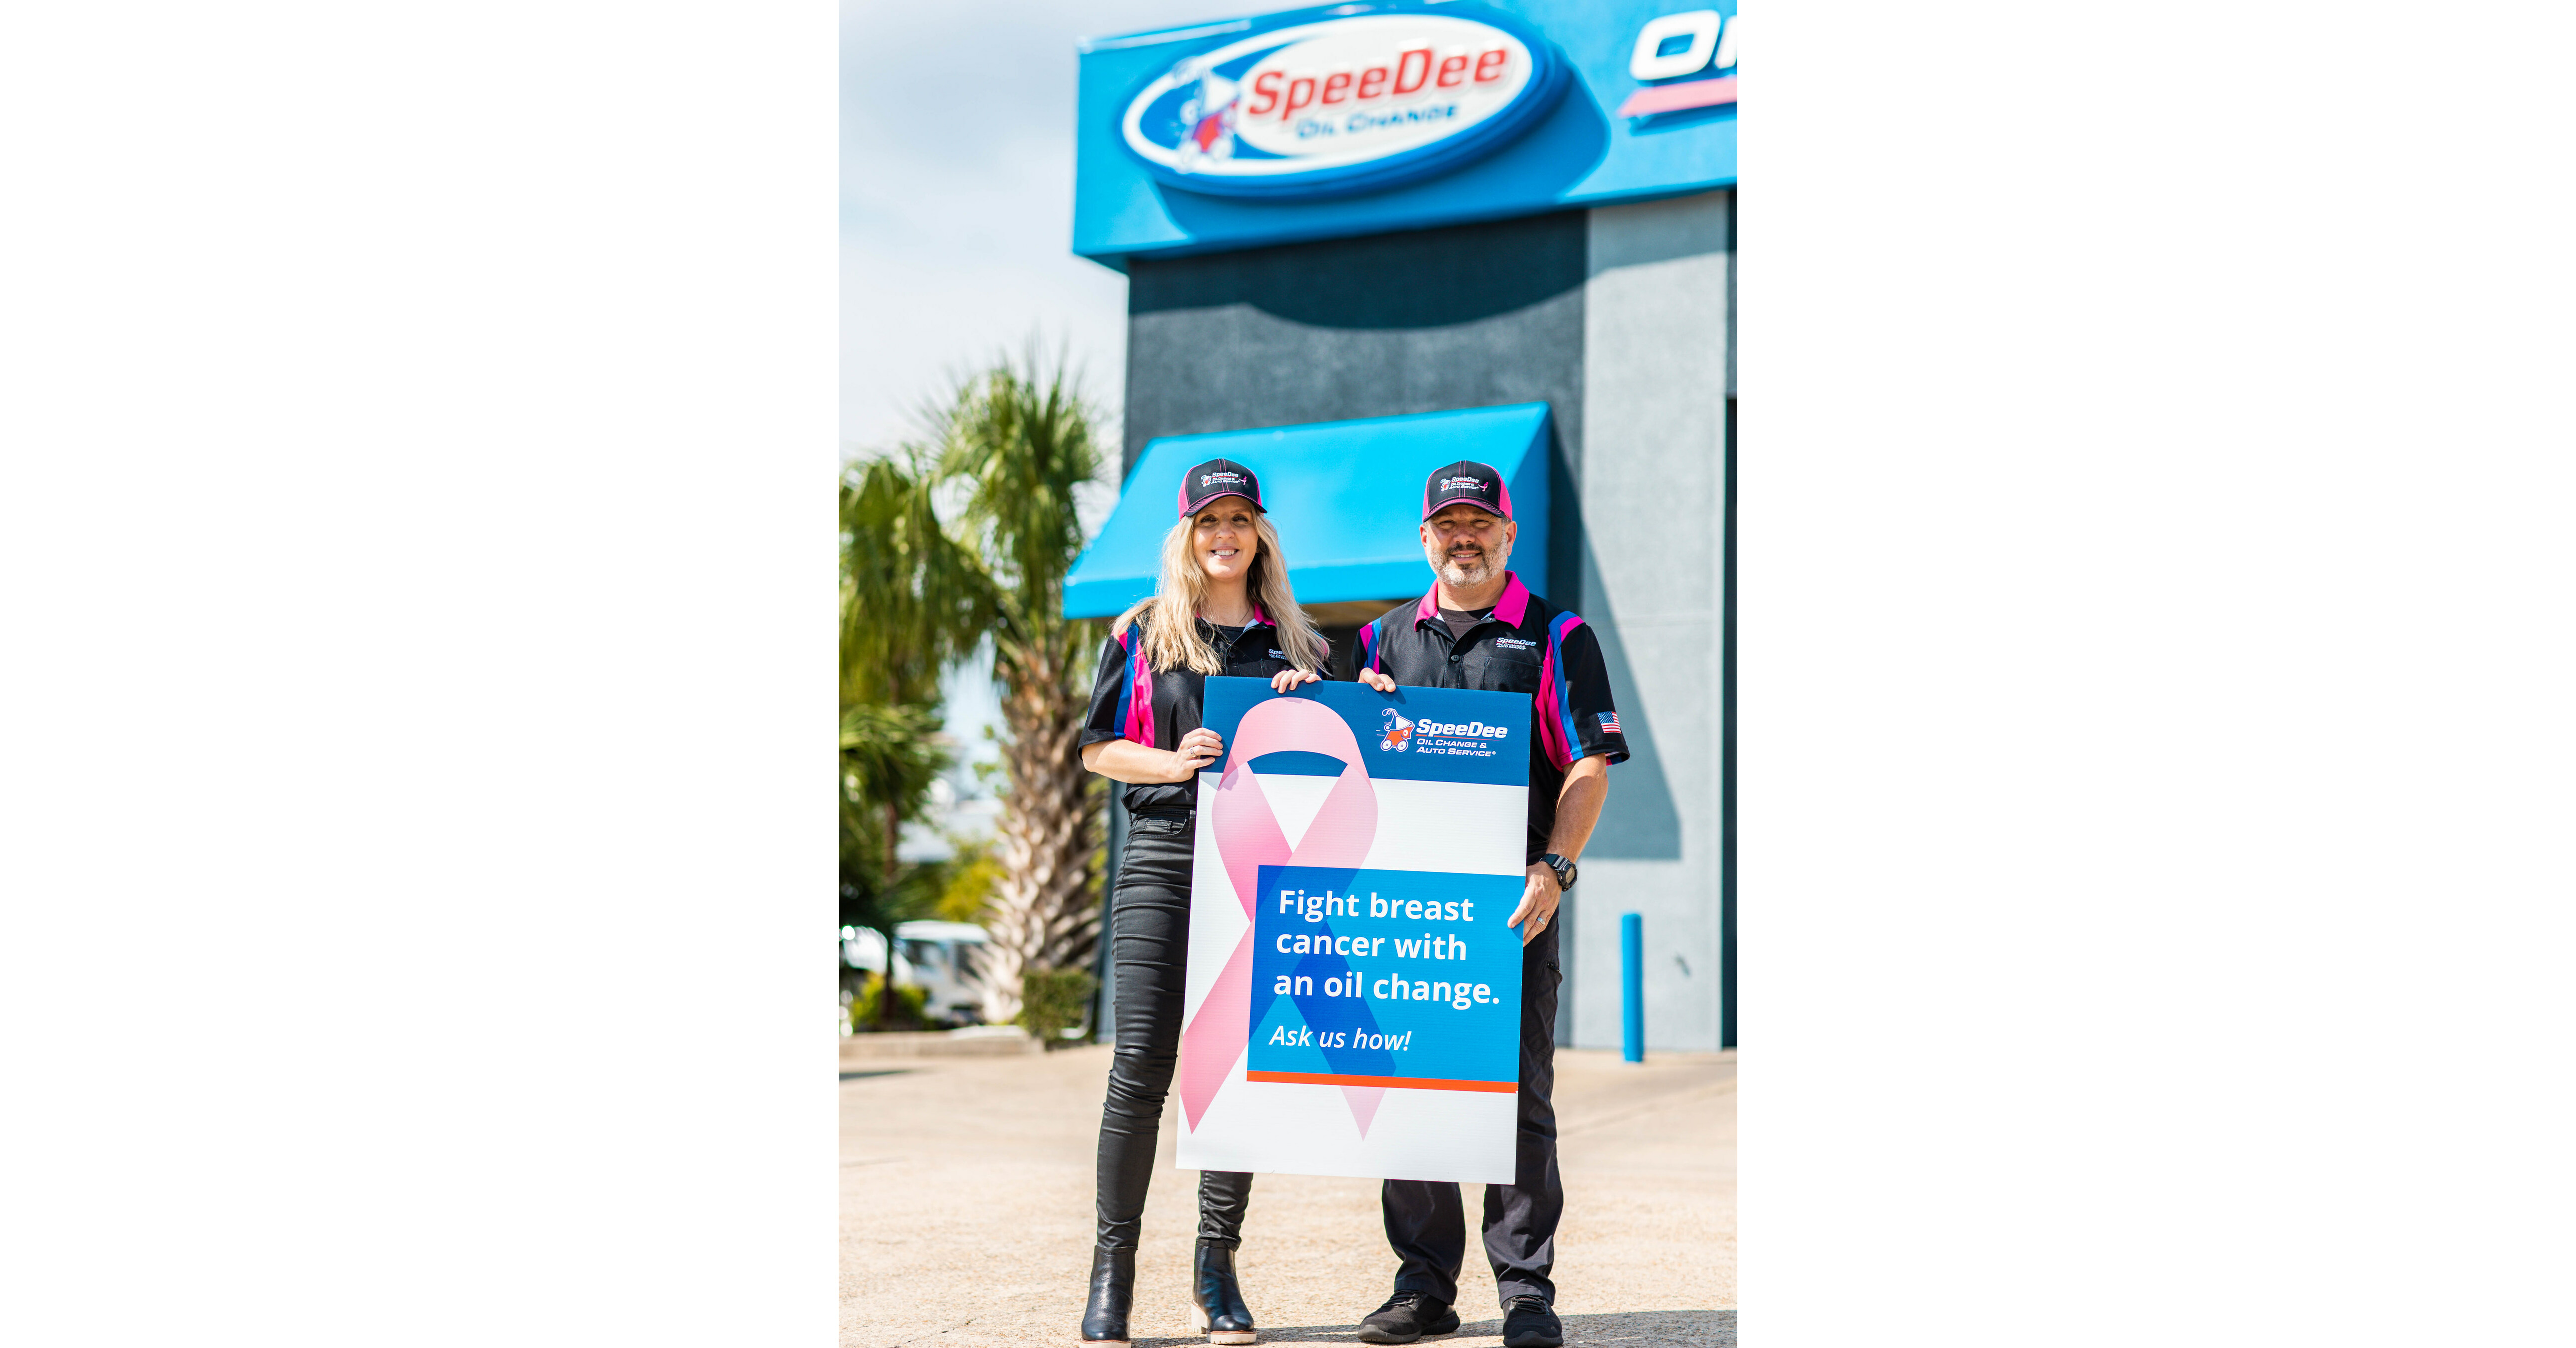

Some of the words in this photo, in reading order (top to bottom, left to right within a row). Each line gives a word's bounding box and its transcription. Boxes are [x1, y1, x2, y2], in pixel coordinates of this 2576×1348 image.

[1249, 48, 1506, 121] SpeeDee
[1496, 637, 1536, 646] SpeeDee
[1416, 718, 1508, 738] SpeeDee
[1435, 739, 1478, 748] CHANGE
[1279, 889, 1359, 923] Fight
[1370, 892, 1474, 922] breast
[1276, 933, 1385, 957] cancer
[1394, 933, 1466, 960] with
[1274, 974, 1313, 996] an
[1324, 971, 1363, 998] oil
[1373, 973, 1499, 1010] change.
[1269, 1025, 1313, 1047] Ask
[1319, 1031, 1346, 1048] us
[1353, 1027, 1412, 1051] how!
